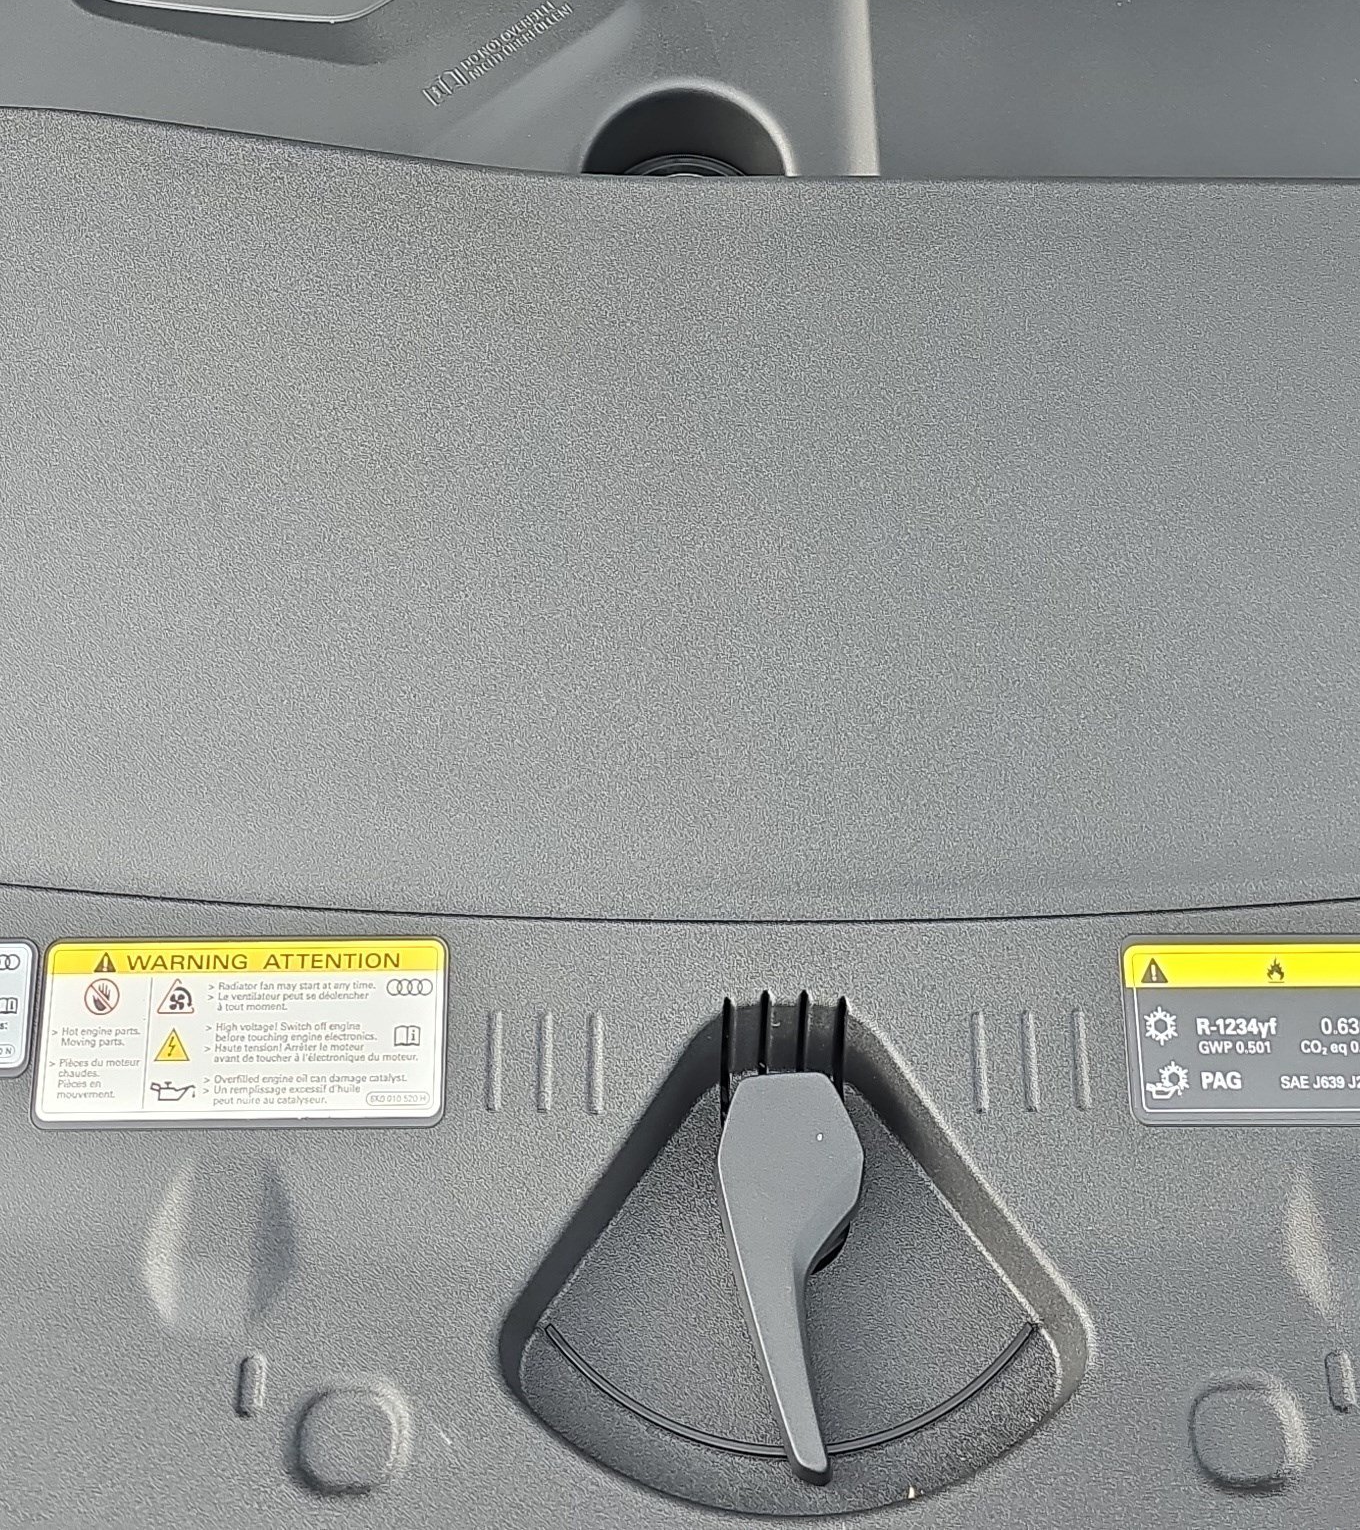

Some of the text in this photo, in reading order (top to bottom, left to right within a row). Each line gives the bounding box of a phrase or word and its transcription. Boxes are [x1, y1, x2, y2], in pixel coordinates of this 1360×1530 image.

[126, 954, 247, 970] WARNING
[262, 953, 399, 969] ATTENTION
[218, 981, 376, 991] Radiator fan may start at any time.
[217, 992, 229, 1000] Le
[282, 992, 303, 1001] peut
[216, 1002, 222, 1011] à
[225, 1003, 244, 1011] tout
[61, 1026, 141, 1037] Hot engine parts.
[215, 1022, 237, 1033] High
[280, 1022, 312, 1031] Switch
[314, 1022, 327, 1031] off
[328, 1022, 360, 1032] engine
[1196, 1017, 1277, 1038] R-1234yf
[60, 1037, 124, 1048] Moving parts.
[215, 1032, 377, 1043] before touching engine electronics.
[214, 1043, 242, 1052] Haute
[319, 1043, 328, 1051] le
[330, 1043, 364, 1051] moteur
[1198, 1040, 1271, 1054] GWP 0.501
[1330, 1043, 1347, 1056] eq
[59, 1058, 88, 1067] Pièces
[90, 1058, 103, 1066] du
[213, 1054, 240, 1062] avant
[241, 1053, 254, 1062] de
[255, 1053, 292, 1062] toucher
[293, 1053, 299, 1062] à
[367, 1052, 379, 1061] du
[382, 1053, 418, 1061] moteur.
[58, 1069, 100, 1077] chaudes.
[214, 1073, 407, 1084] Overfilled engine oil can damage catalyst.
[57, 1079, 101, 1088] Pièces en
[1200, 1071, 1241, 1089] PAG
[1280, 1075, 1310, 1088] SAE
[1312, 1075, 1345, 1088] J639
[56, 1090, 115, 1099] mouvement.
[213, 1085, 227, 1094] Un
[229, 1084, 286, 1095] remplissage
[288, 1084, 327, 1093] excessif
[212, 1097, 233, 1106] peut
[236, 1095, 260, 1104] nuire
[276, 1095, 327, 1104] catalyseur.
